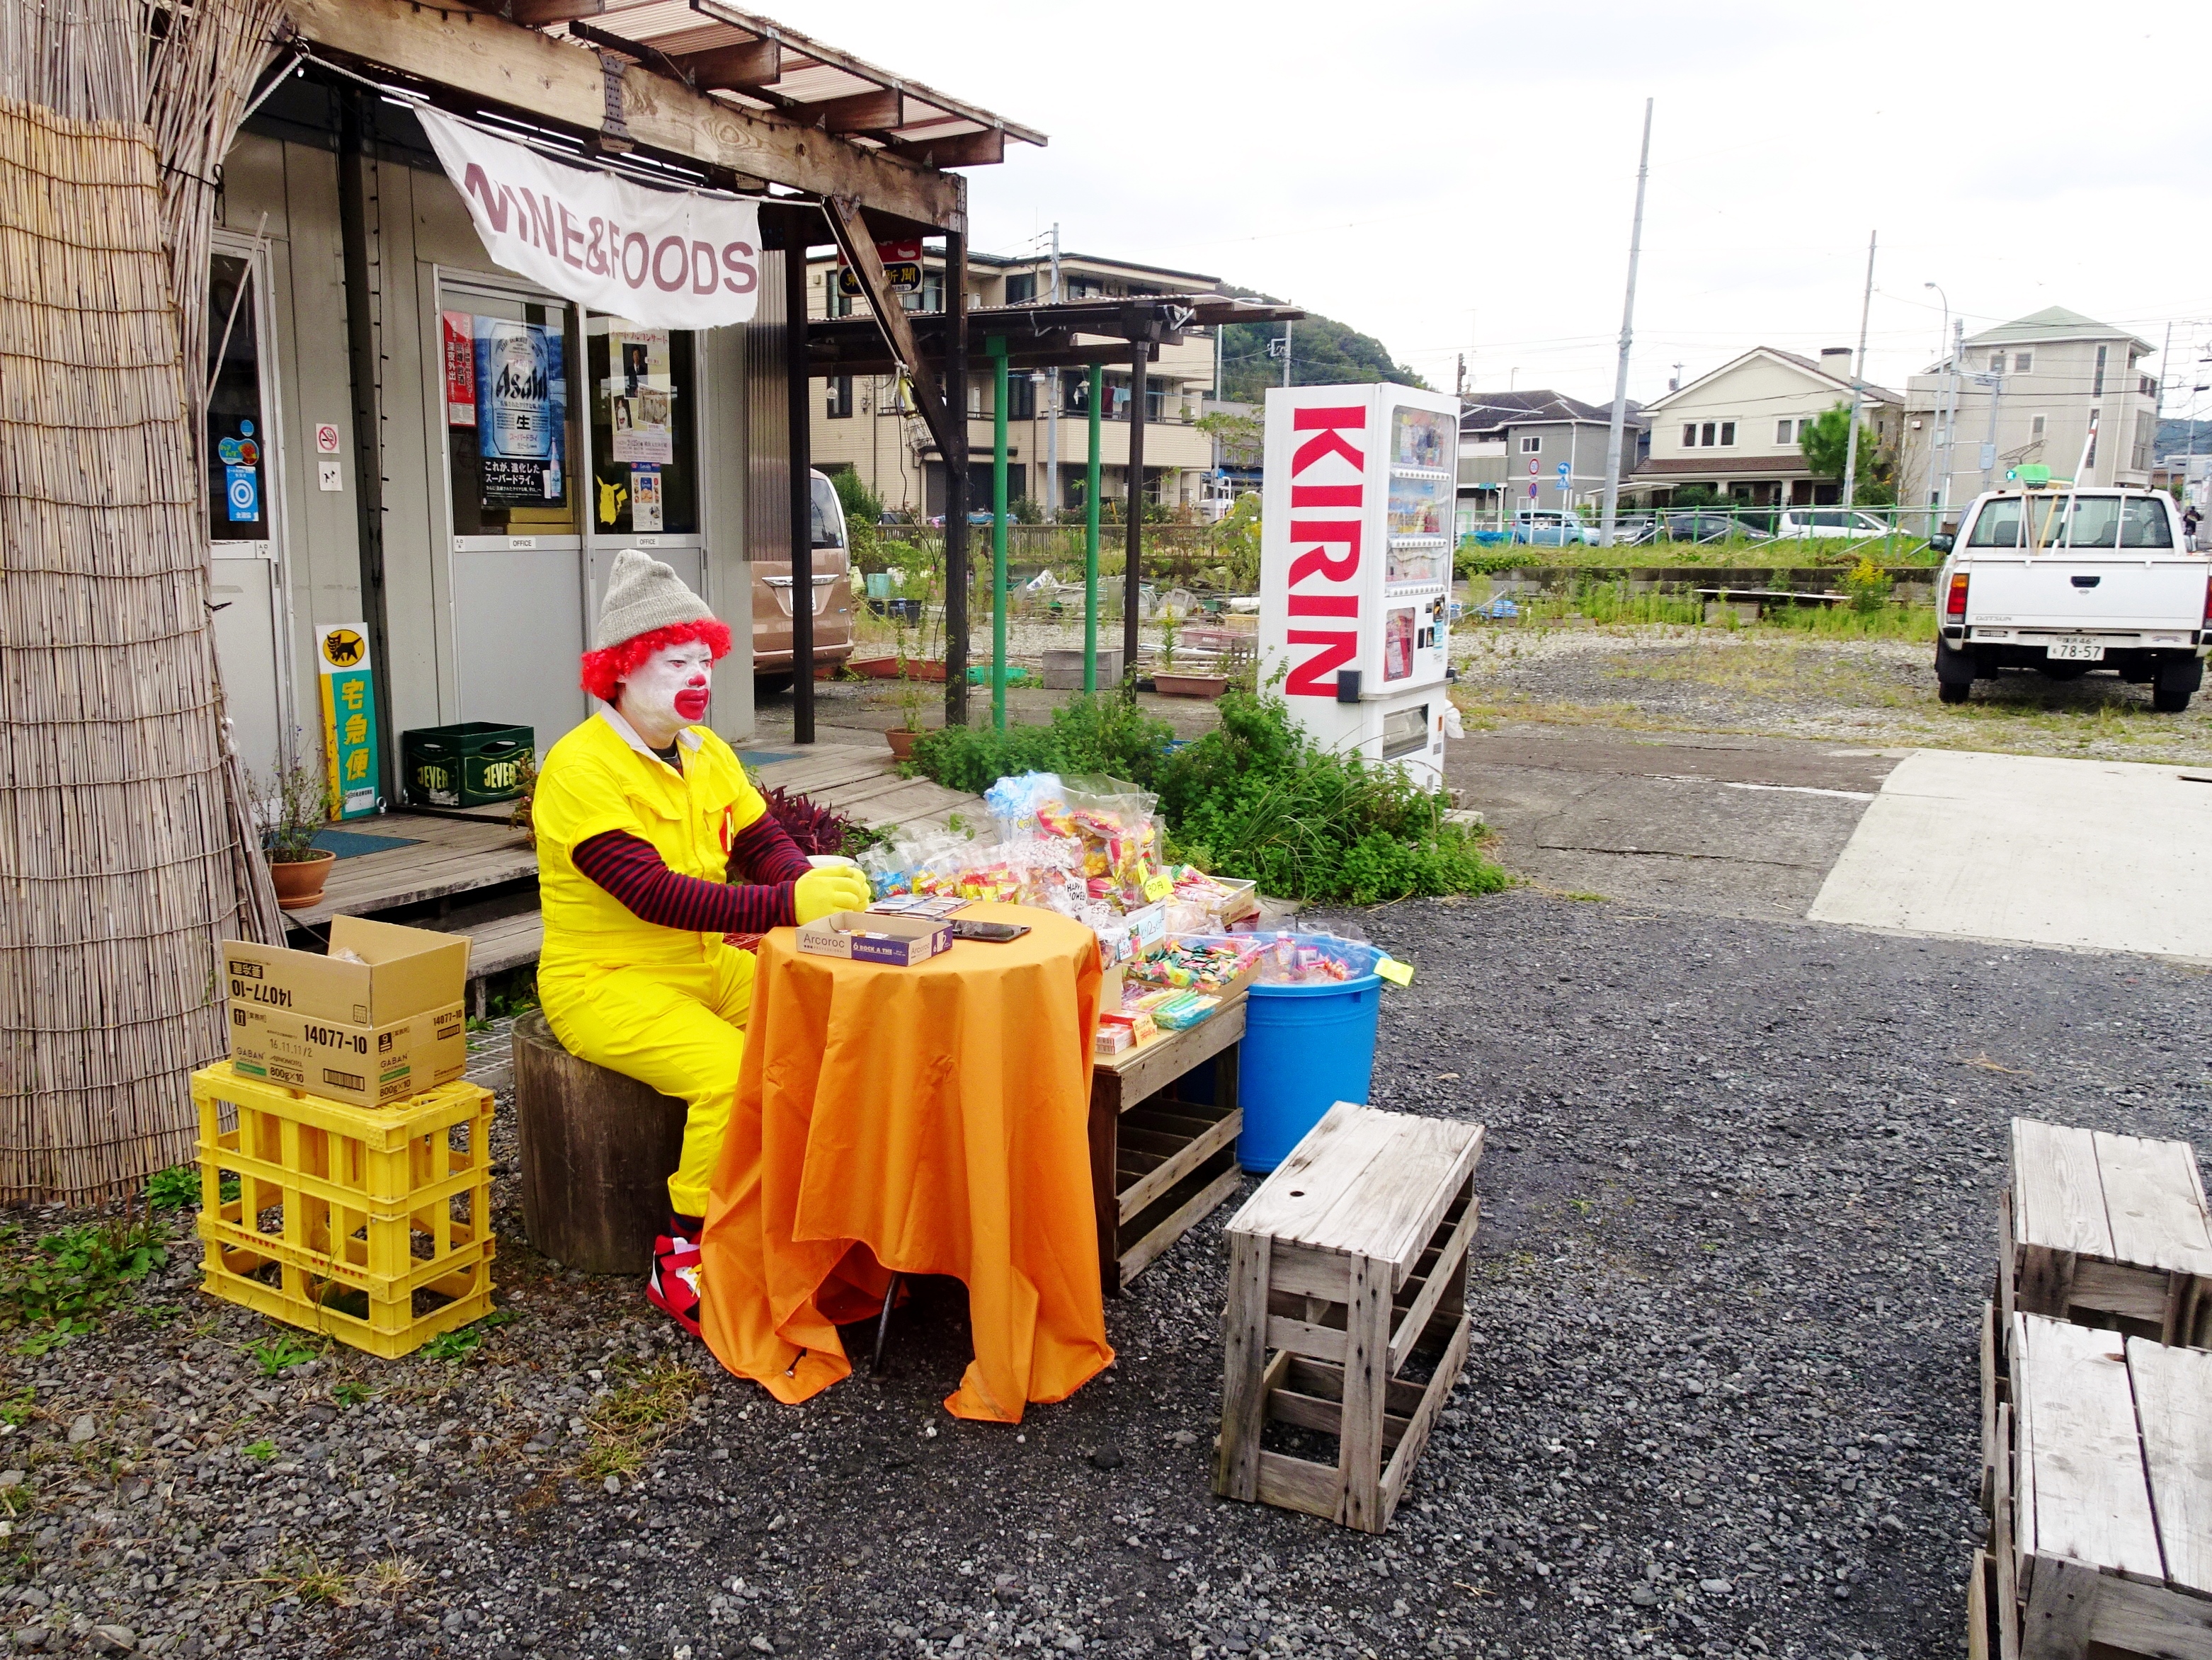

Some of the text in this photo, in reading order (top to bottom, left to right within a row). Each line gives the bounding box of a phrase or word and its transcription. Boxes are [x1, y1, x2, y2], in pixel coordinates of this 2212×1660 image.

[845, 268, 916, 287] 東新聞
[496, 363, 548, 402] Asahi
[516, 414, 530, 430] 生
[509, 433, 538, 442] スーパードライ
[485, 462, 541, 474] これが、進化した
[486, 474, 535, 486] スーパードライ。
[1285, 405, 1367, 697] KIRIN
[2060, 645, 2101, 658] 78-57
[341, 678, 370, 782] 宅急便
[416, 765, 449, 789] JEVER
[484, 762, 516, 789] JEVER
[1146, 881, 1163, 895] 30円
[804, 933, 845, 948] Arcoroc
[911, 943, 930, 955] Arcoroc
[933, 944, 937, 953] 6
[232, 979, 292, 1007] 14077-10
[433, 1009, 462, 1026] 14077-10
[304, 1024, 367, 1054] 14077-10
[236, 1046, 264, 1060] GABAN
[380, 1053, 408, 1068] GABAN
